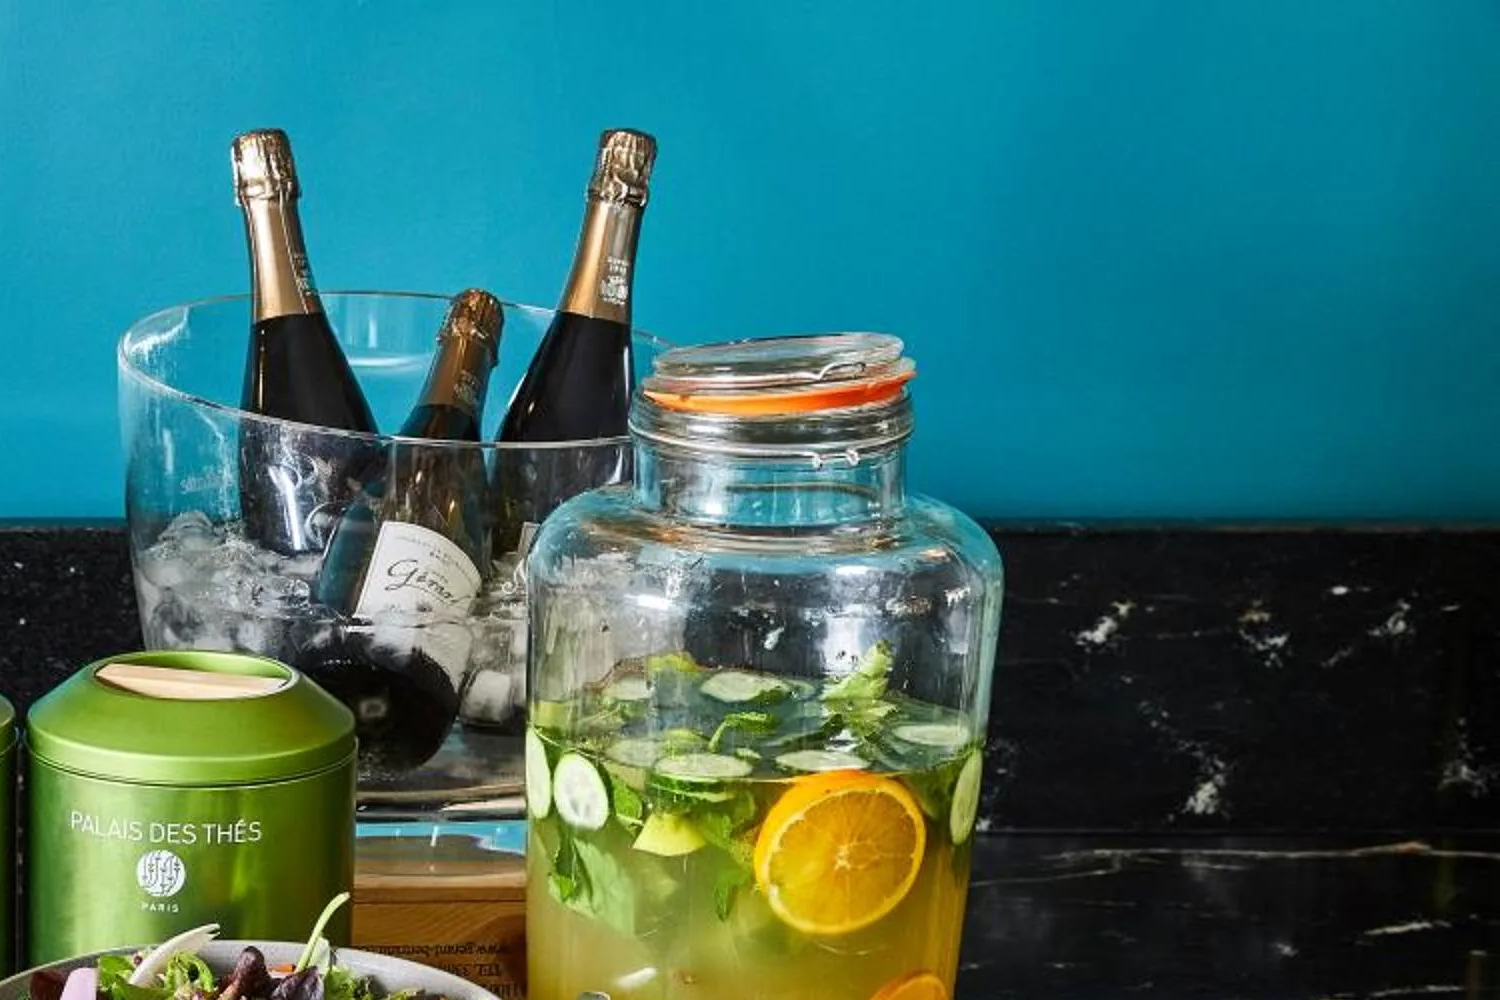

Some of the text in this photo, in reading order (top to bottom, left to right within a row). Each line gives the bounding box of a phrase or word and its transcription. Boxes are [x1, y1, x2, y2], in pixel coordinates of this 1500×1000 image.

[71, 810, 262, 844] PALAIS DES THÉS
[141, 902, 179, 913] PARIS
